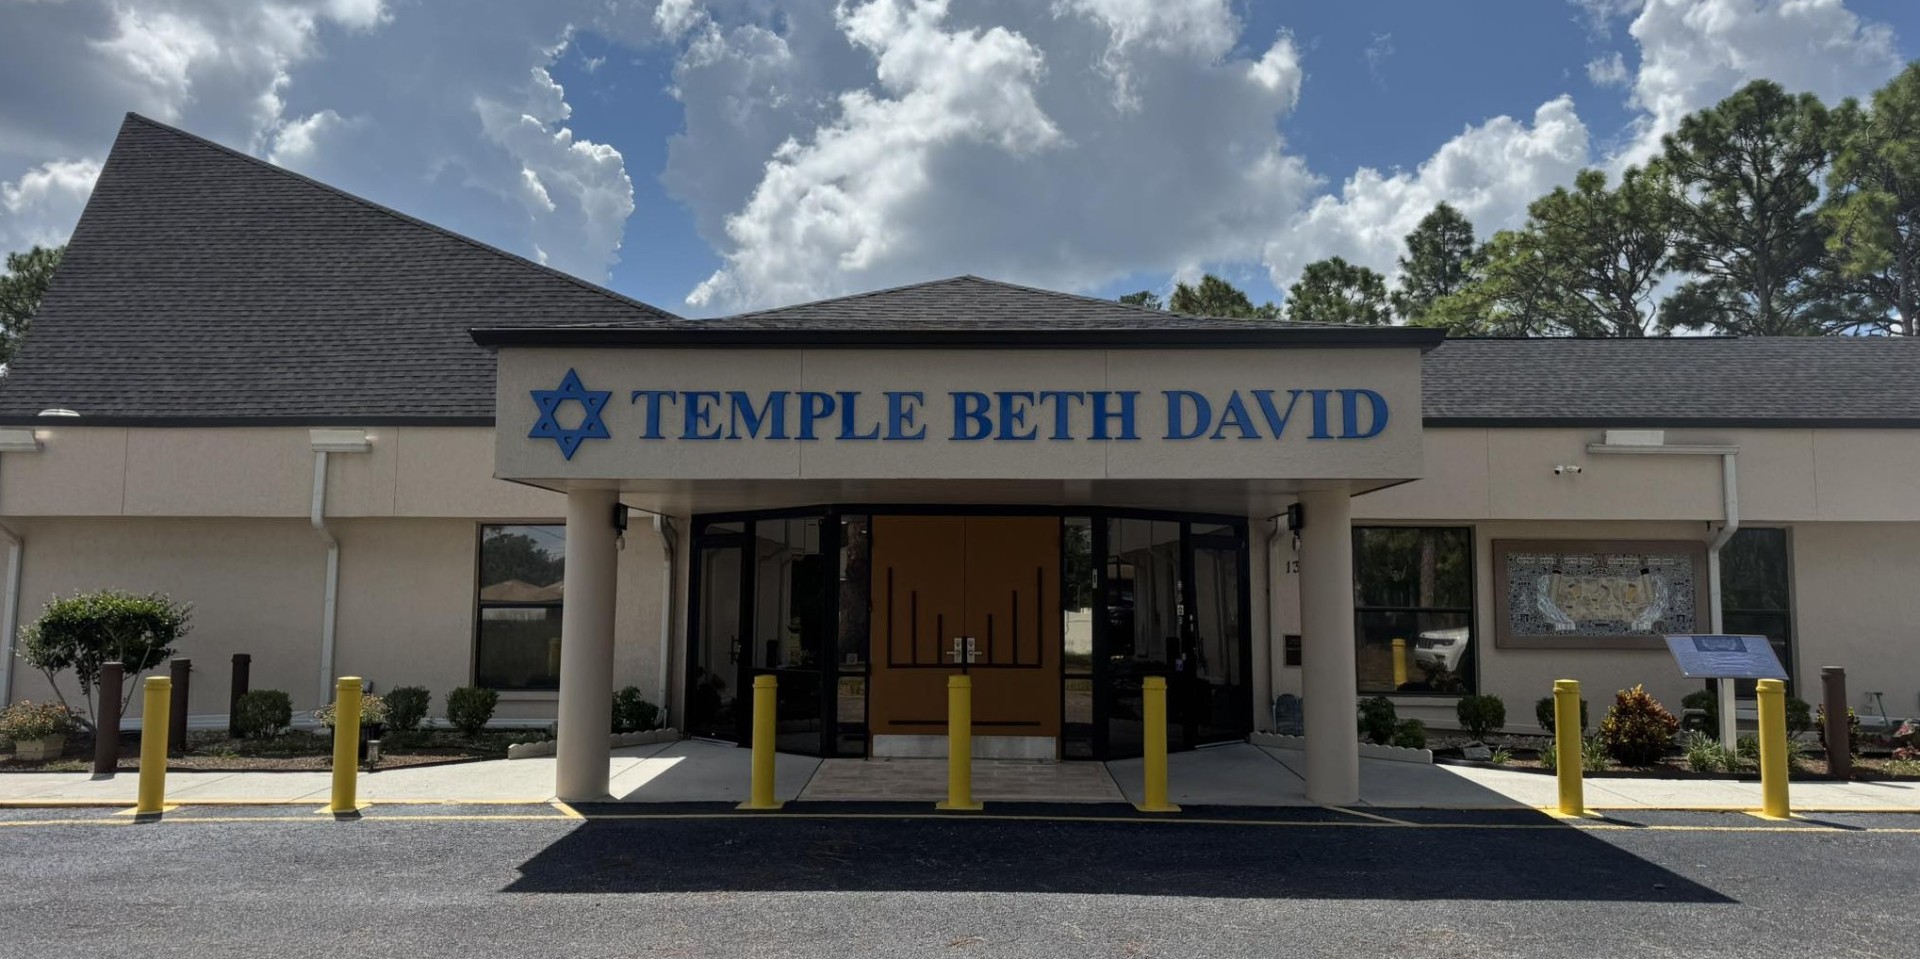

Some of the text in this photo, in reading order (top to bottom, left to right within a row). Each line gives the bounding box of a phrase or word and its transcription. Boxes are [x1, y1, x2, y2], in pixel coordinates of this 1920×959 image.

[631, 389, 1390, 441] TEMPLE BETH DAVID
